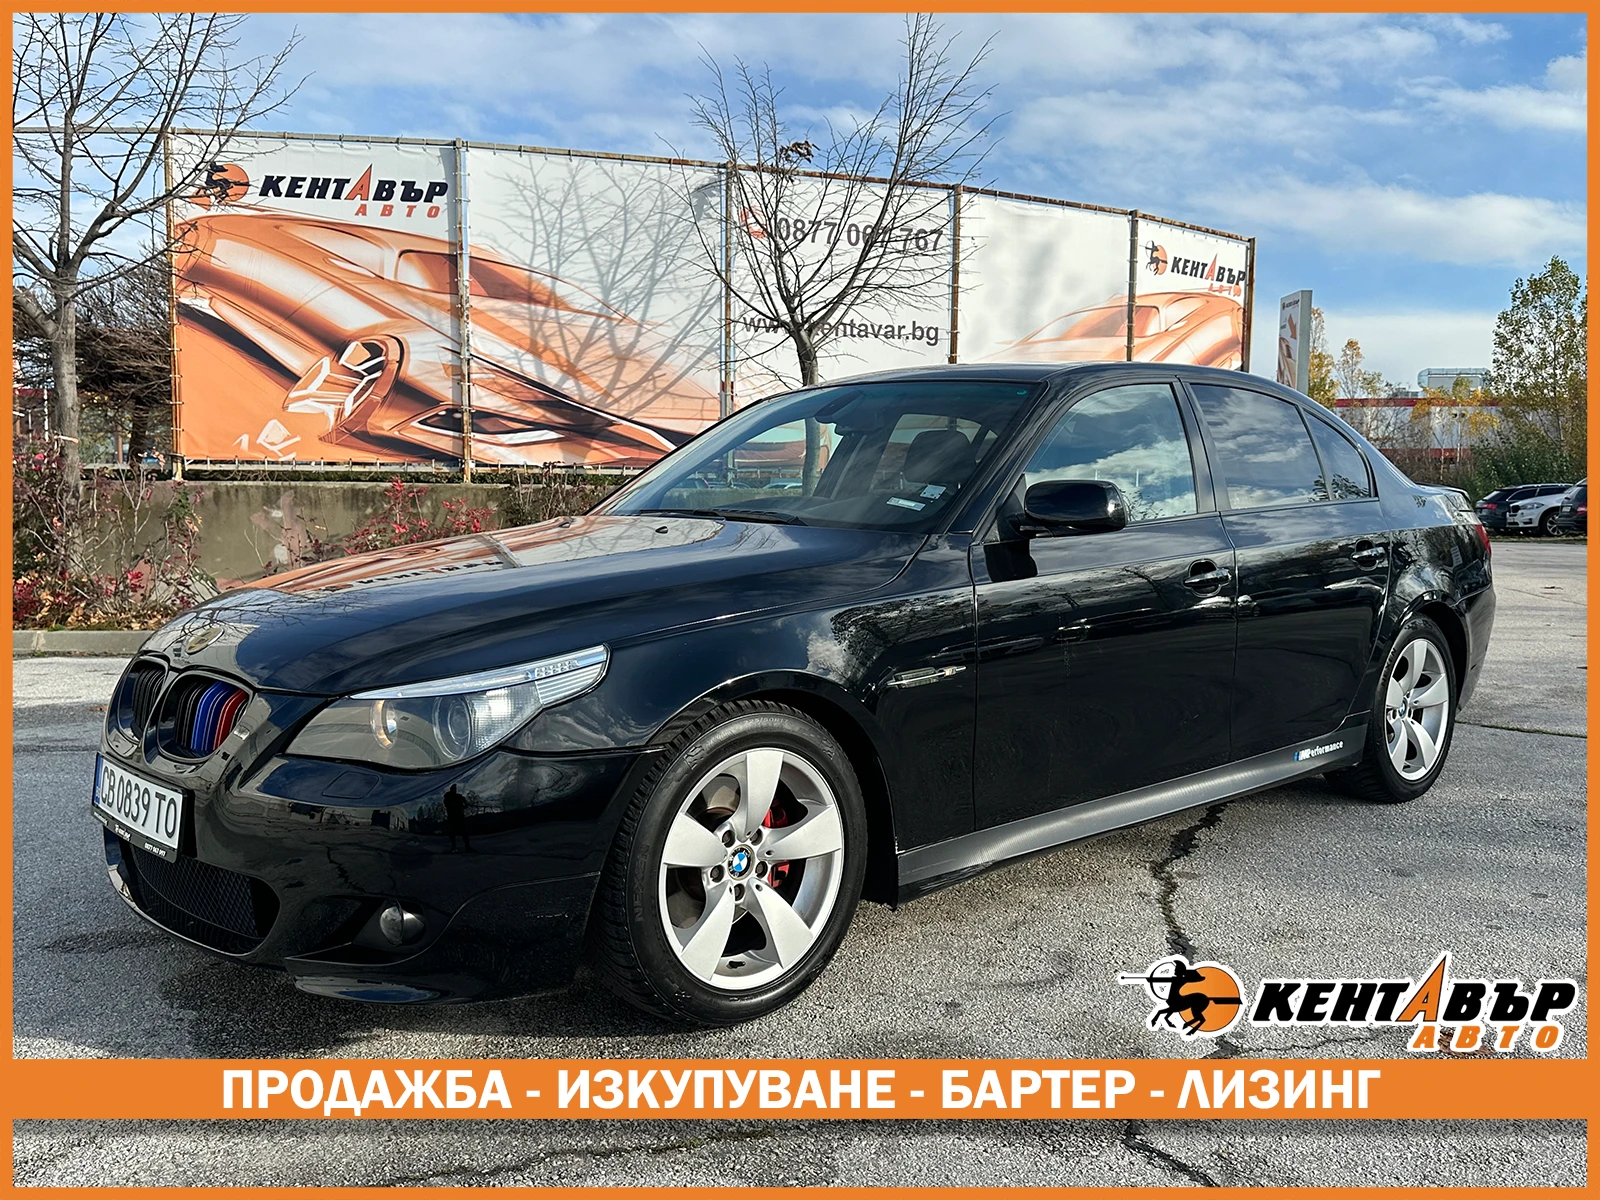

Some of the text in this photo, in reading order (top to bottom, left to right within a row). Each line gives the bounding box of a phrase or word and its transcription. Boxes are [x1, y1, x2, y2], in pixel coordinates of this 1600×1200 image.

[258, 163, 449, 203] КЕНТАВЪР
[354, 203, 441, 218] АВТО
[776, 217, 838, 244] 0877
[899, 227, 944, 252] 767
[1170, 253, 1246, 286] КЕНТАВЪР
[742, 316, 940, 347] wwentavar.bg
[101, 766, 177, 839] CB 0839 TO
